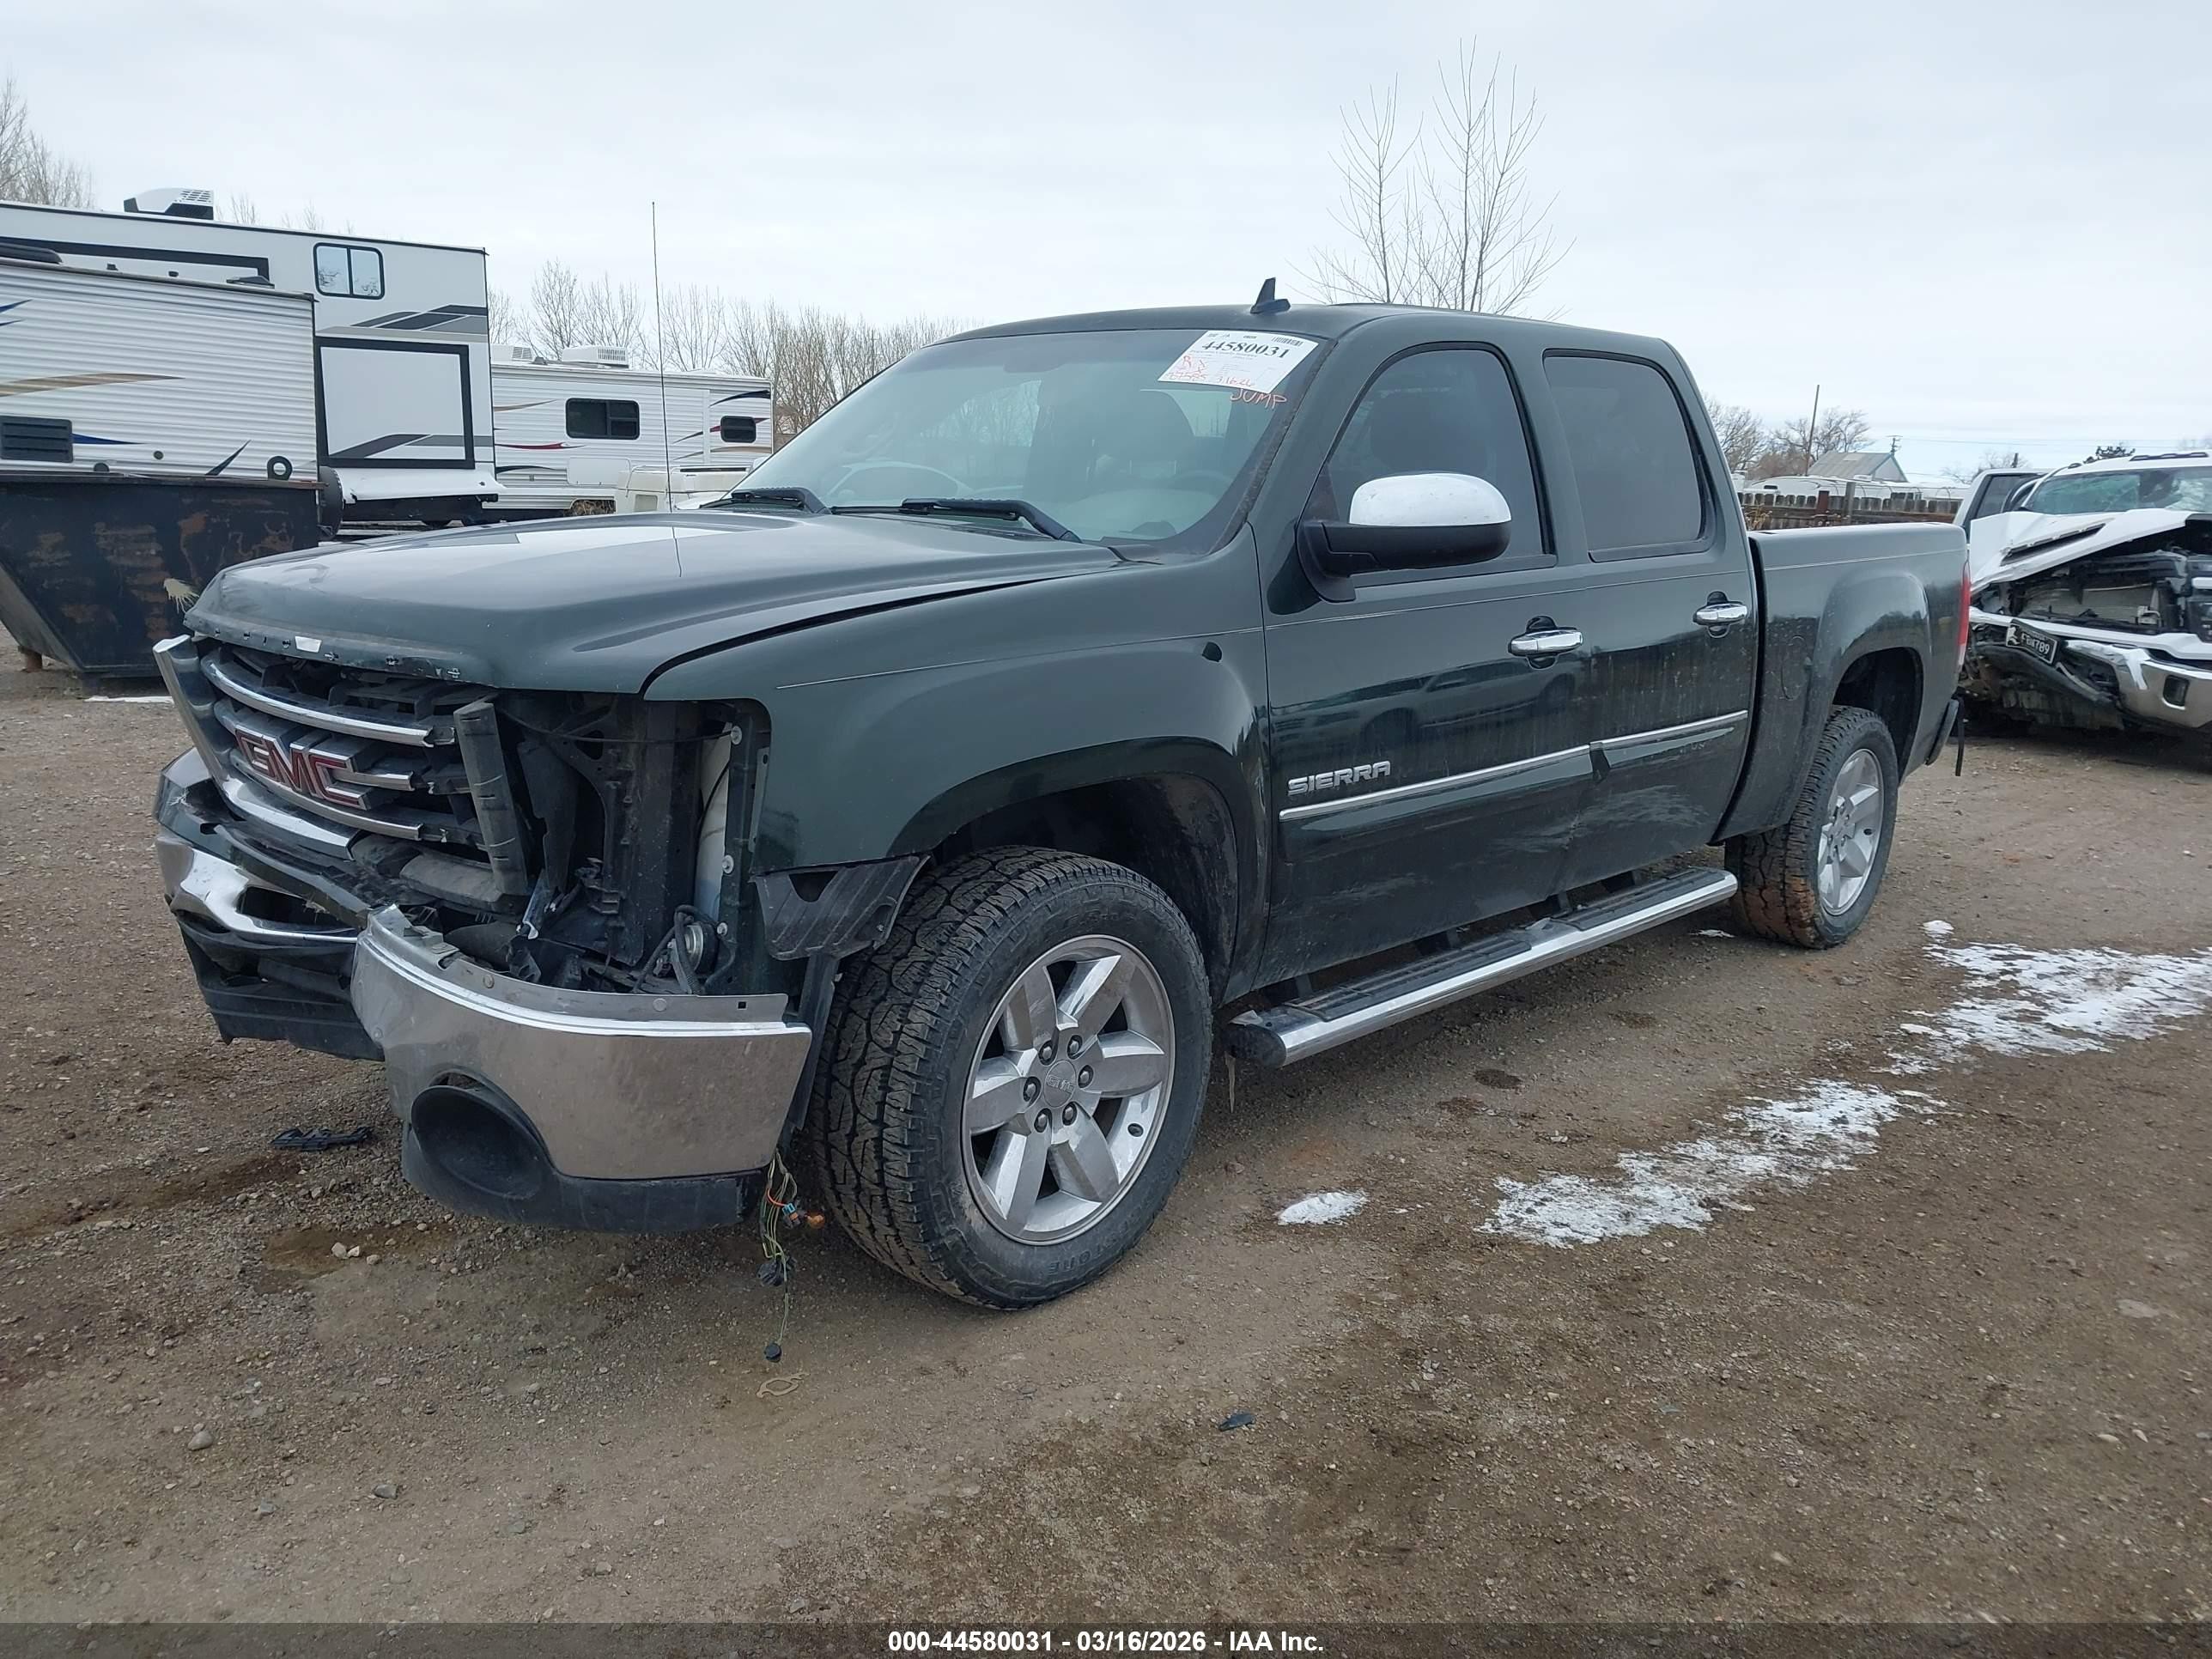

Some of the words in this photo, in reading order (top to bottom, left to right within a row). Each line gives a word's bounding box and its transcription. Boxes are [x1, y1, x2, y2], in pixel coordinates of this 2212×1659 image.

[1202, 341, 1290, 358] 44580031
[1230, 388, 1287, 410] JUMP
[235, 724, 367, 810] GMC
[1288, 761, 1391, 796] SIERRA
